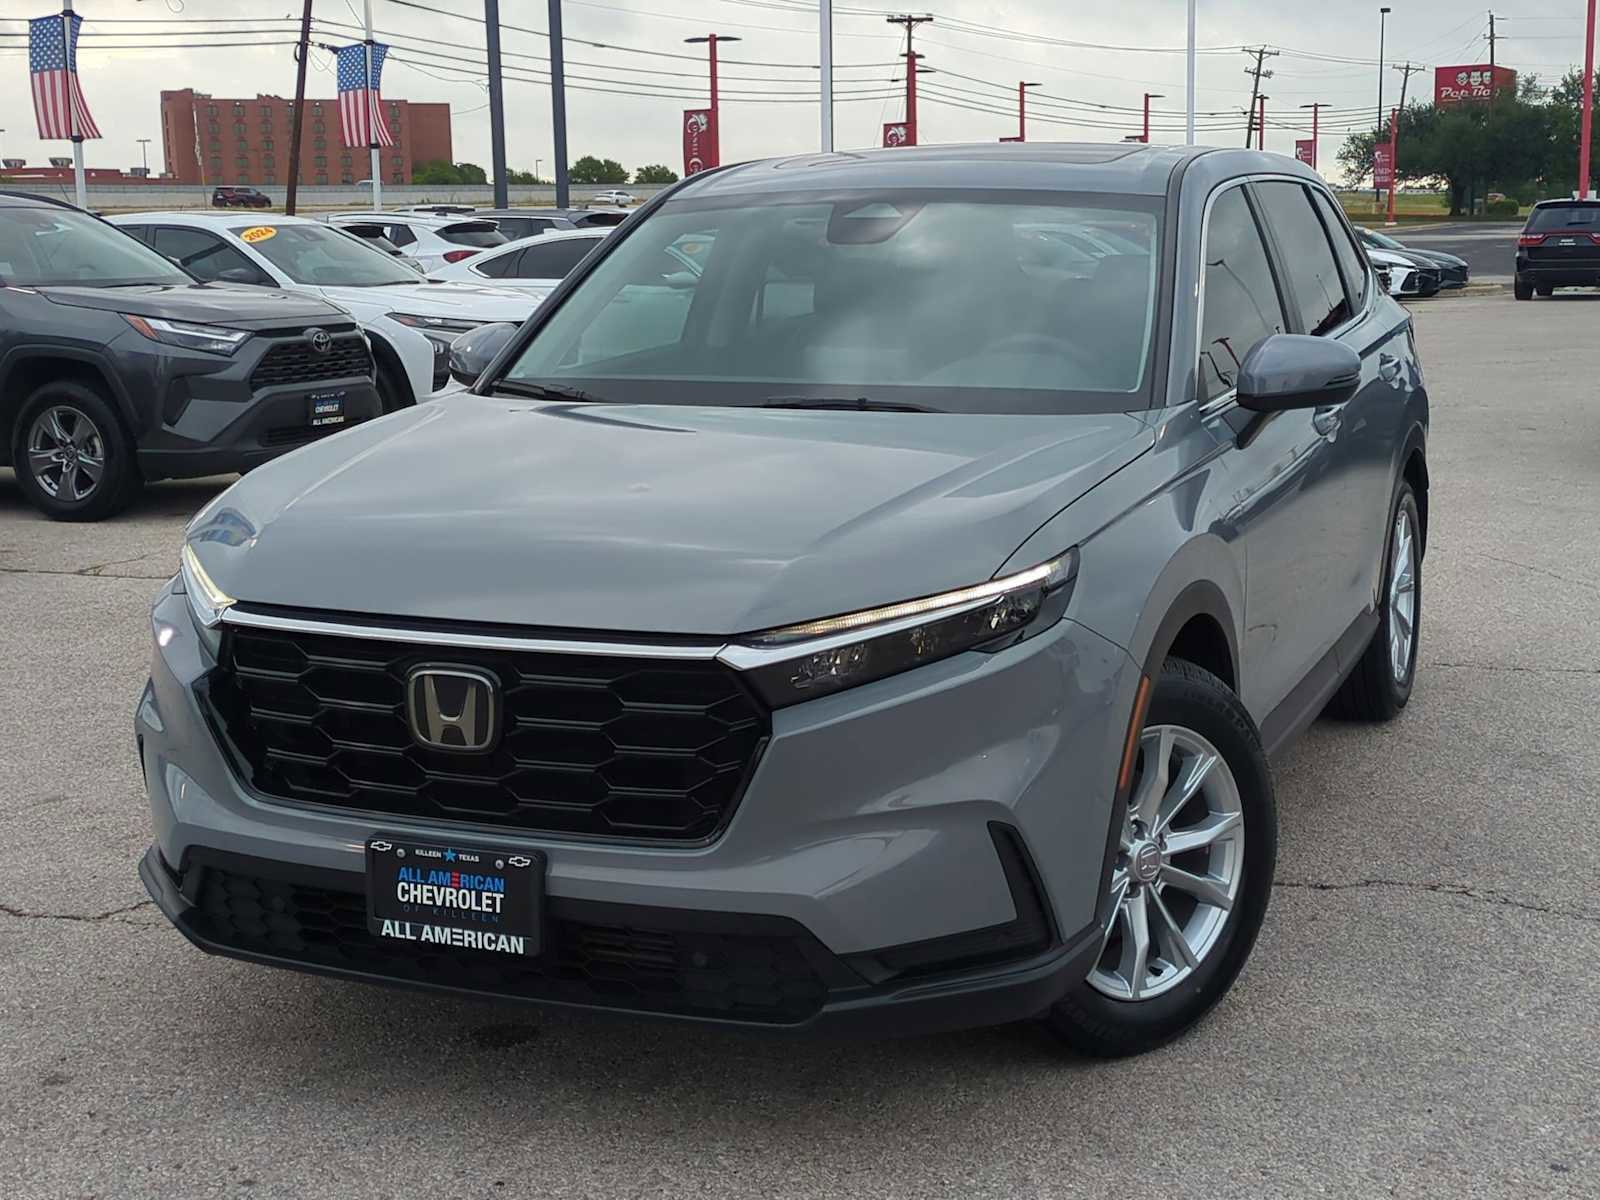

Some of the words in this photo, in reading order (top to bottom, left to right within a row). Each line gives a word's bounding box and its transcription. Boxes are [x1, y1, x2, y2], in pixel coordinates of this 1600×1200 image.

[243, 227, 273, 241] 2024
[415, 849, 442, 858] KILLEEN
[458, 853, 480, 862] TEXAS
[398, 867, 425, 883] ALL
[428, 870, 505, 892] AMERICAN
[397, 882, 505, 913] CHEVROLET
[403, 904, 420, 913] OF
[432, 907, 499, 923] KILLEEN
[381, 919, 417, 940] ALL
[421, 925, 524, 954] AMERICAN
